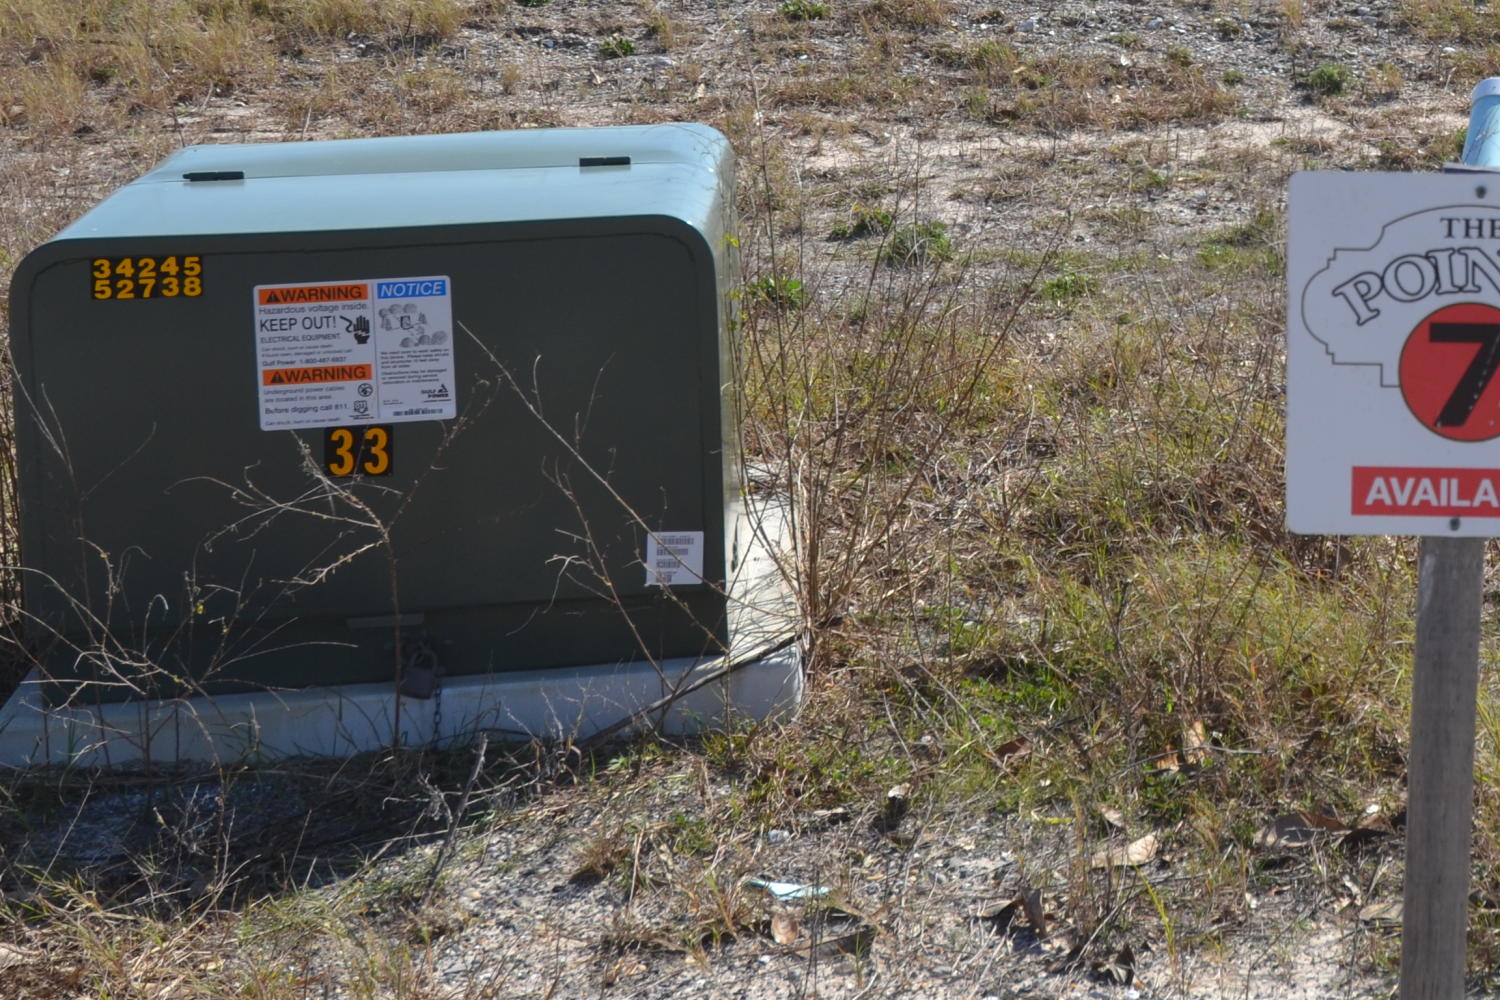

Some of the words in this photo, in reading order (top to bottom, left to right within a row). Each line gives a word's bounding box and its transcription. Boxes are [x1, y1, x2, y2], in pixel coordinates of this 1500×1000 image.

[92, 256, 202, 279] 34245
[94, 276, 202, 300] 52738
[281, 286, 362, 302] WARNING
[380, 281, 443, 297] NOTICE
[259, 306, 305, 315] Hazardous
[308, 304, 339, 314] voltage
[259, 317, 298, 332] KEEP
[302, 315, 337, 330] OUT!
[260, 335, 300, 344] ELECTRICAL
[285, 366, 366, 382] WARNING
[290, 405, 319, 415] digging
[329, 427, 389, 476] 33
